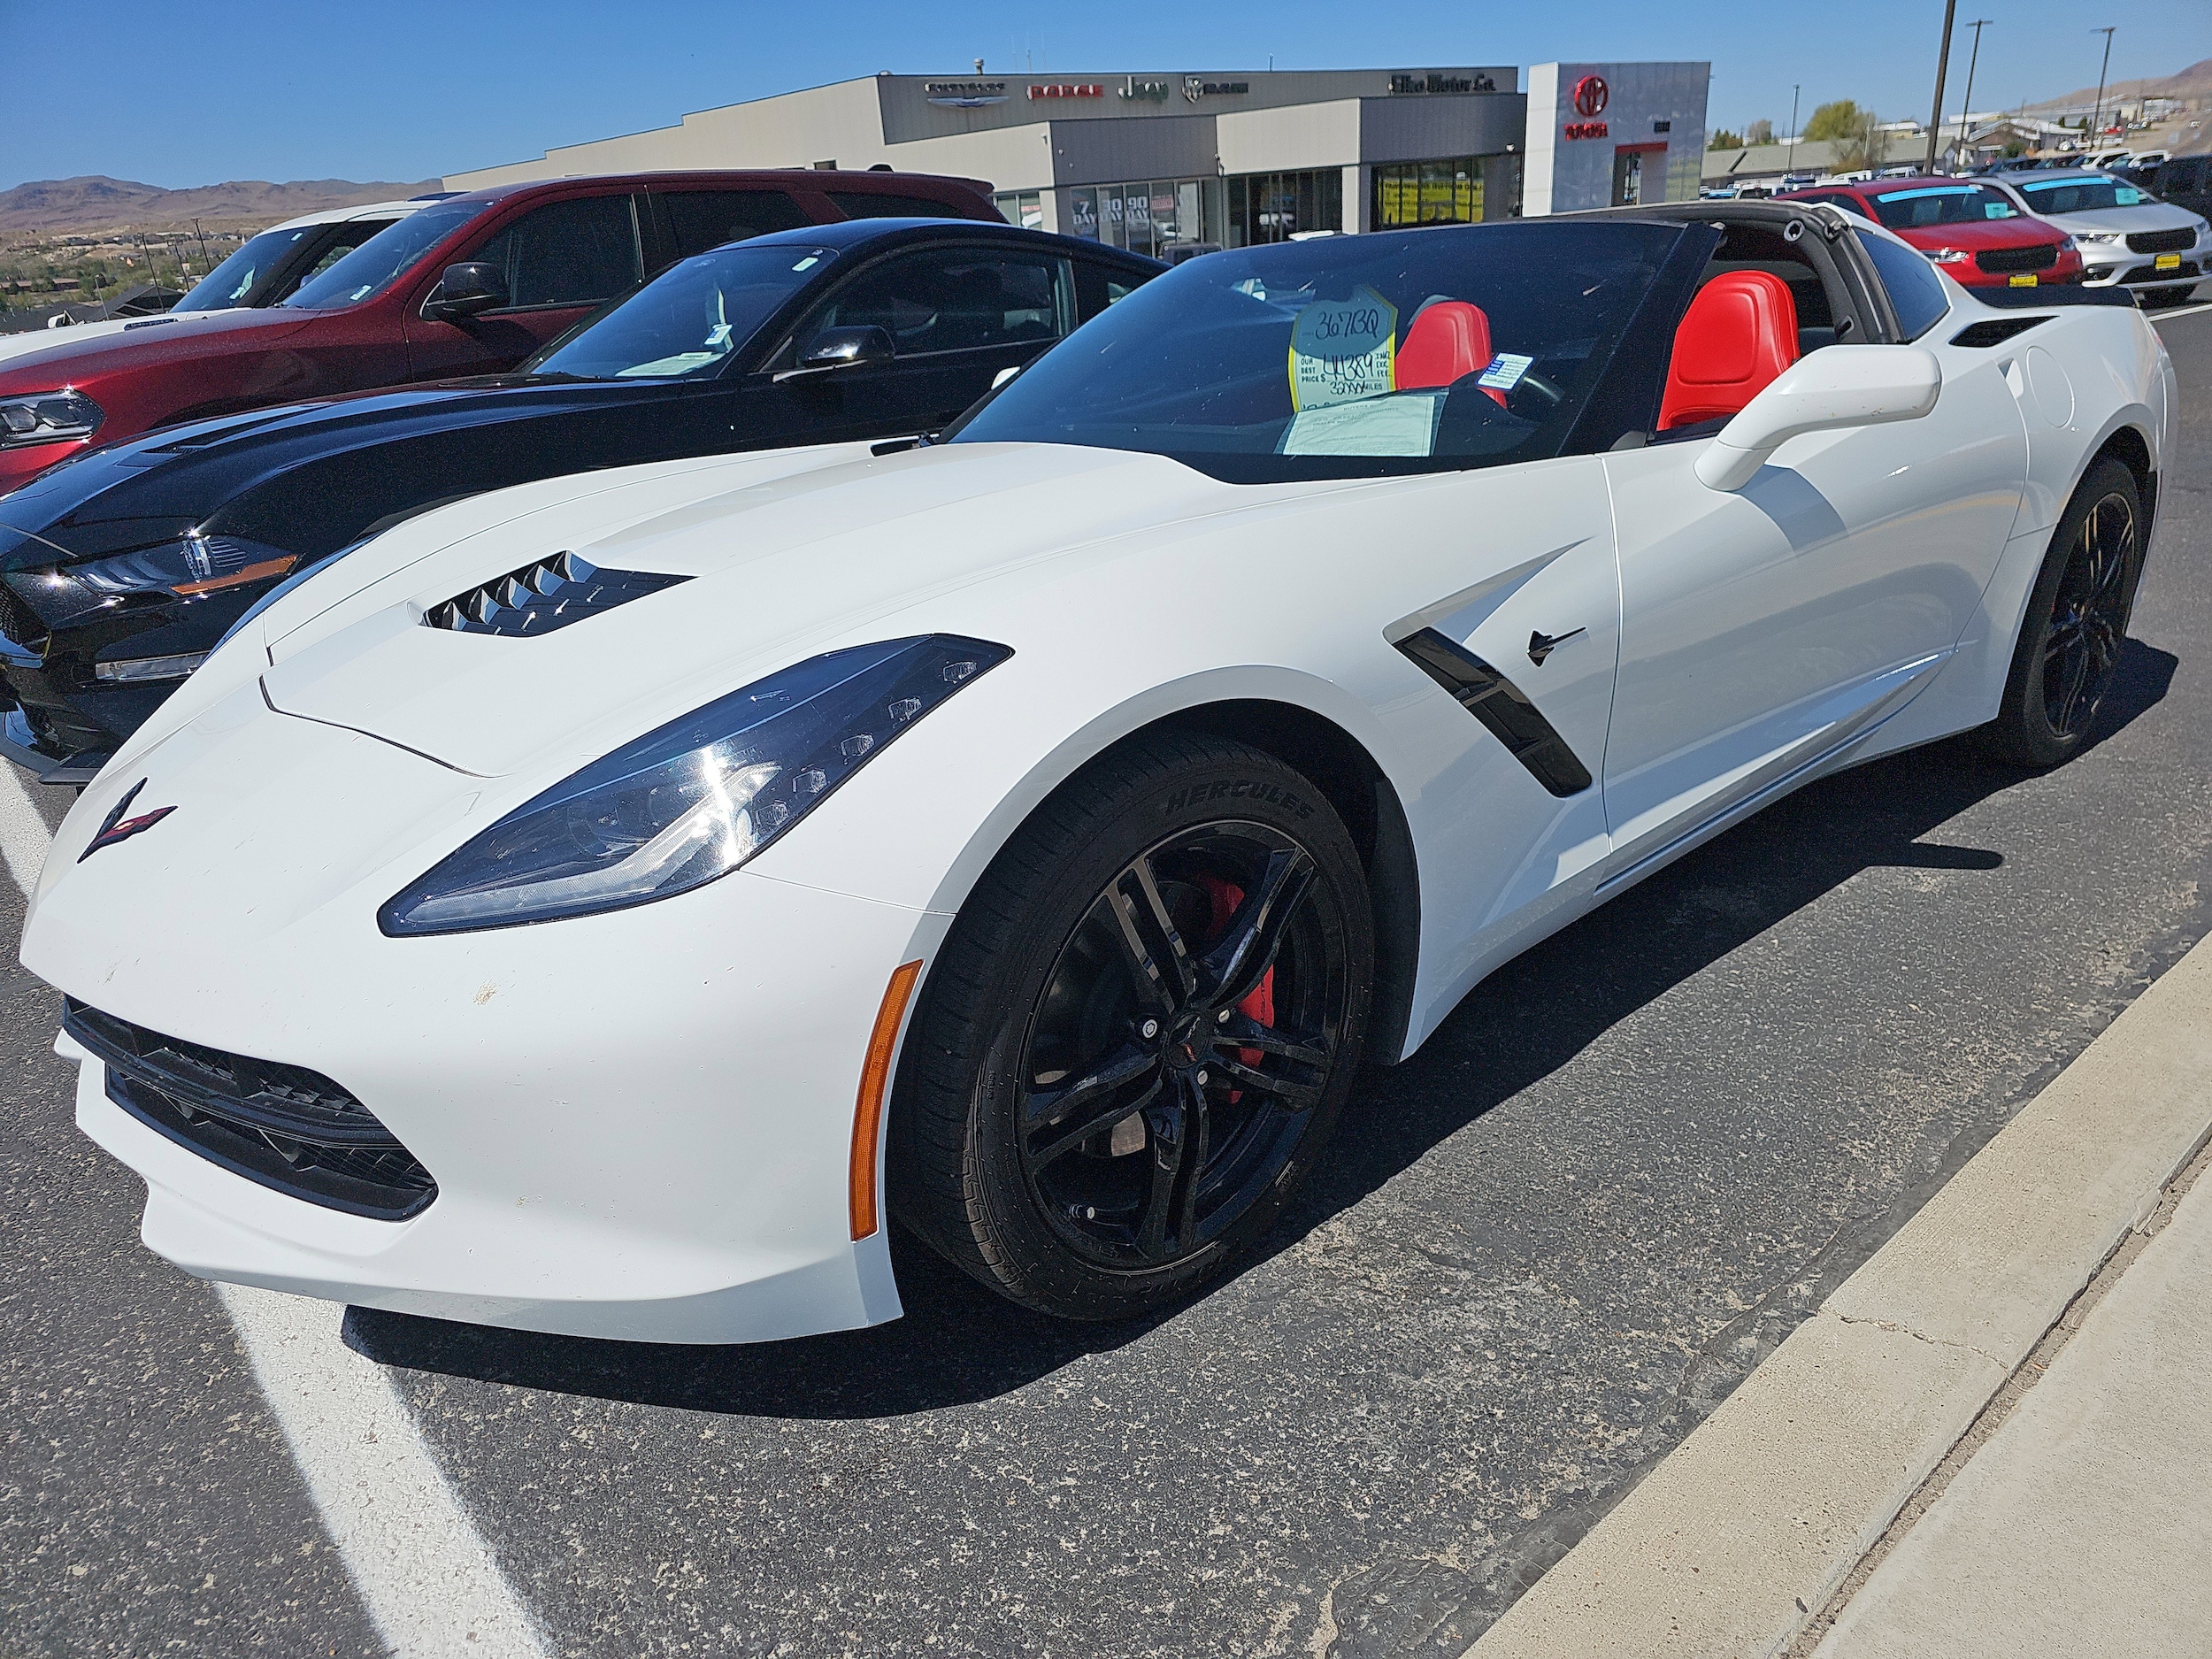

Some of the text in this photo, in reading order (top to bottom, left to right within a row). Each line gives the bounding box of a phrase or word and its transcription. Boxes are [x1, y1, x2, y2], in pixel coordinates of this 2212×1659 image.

[1126, 196, 1148, 210] 90
[1072, 212, 1096, 225] DAY
[1302, 374, 1320, 383] PRICE
[1323, 352, 1374, 381] 44389
[1164, 780, 1316, 820] HERCULES
